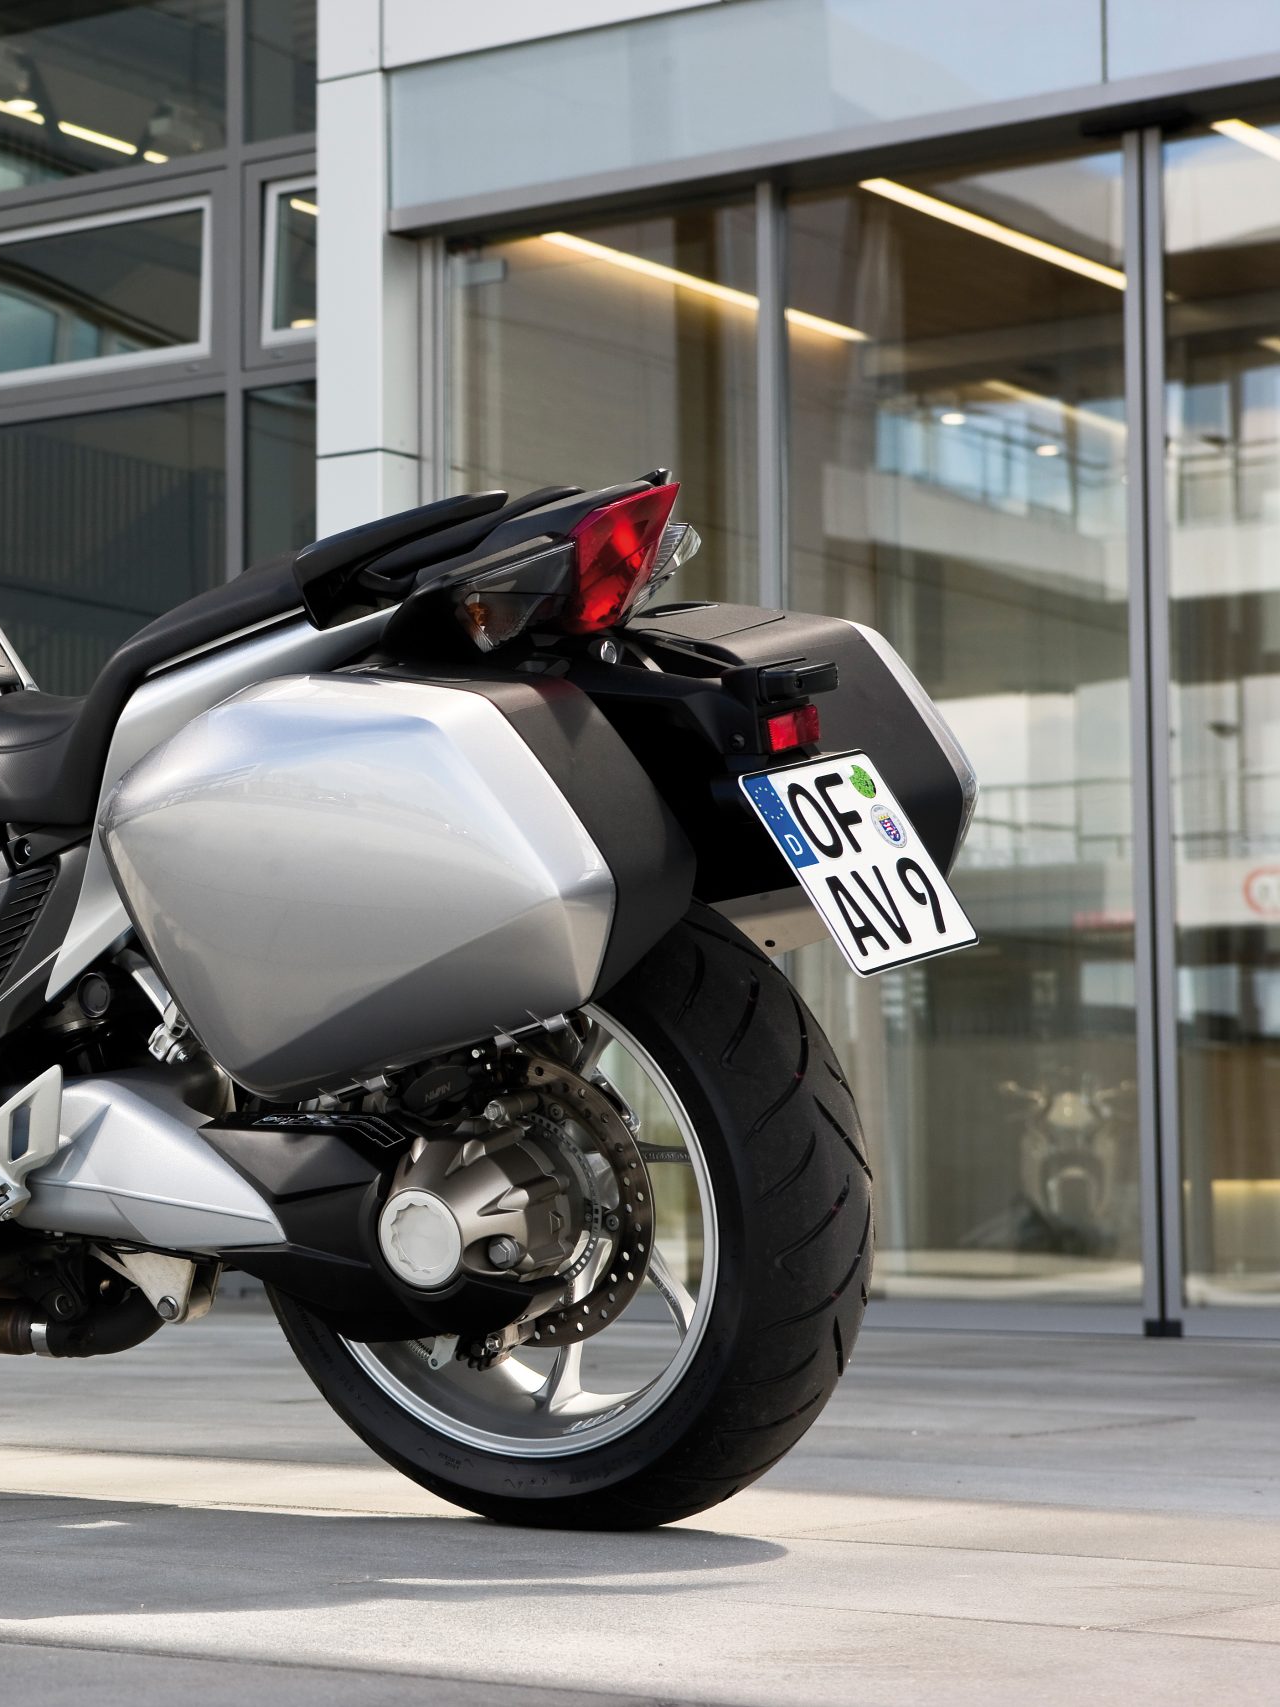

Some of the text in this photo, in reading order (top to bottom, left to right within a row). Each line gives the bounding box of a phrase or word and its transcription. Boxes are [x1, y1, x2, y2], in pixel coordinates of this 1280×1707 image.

[784, 833, 804, 856] D
[787, 772, 863, 859] OF
[825, 857, 947, 957] AV 9
